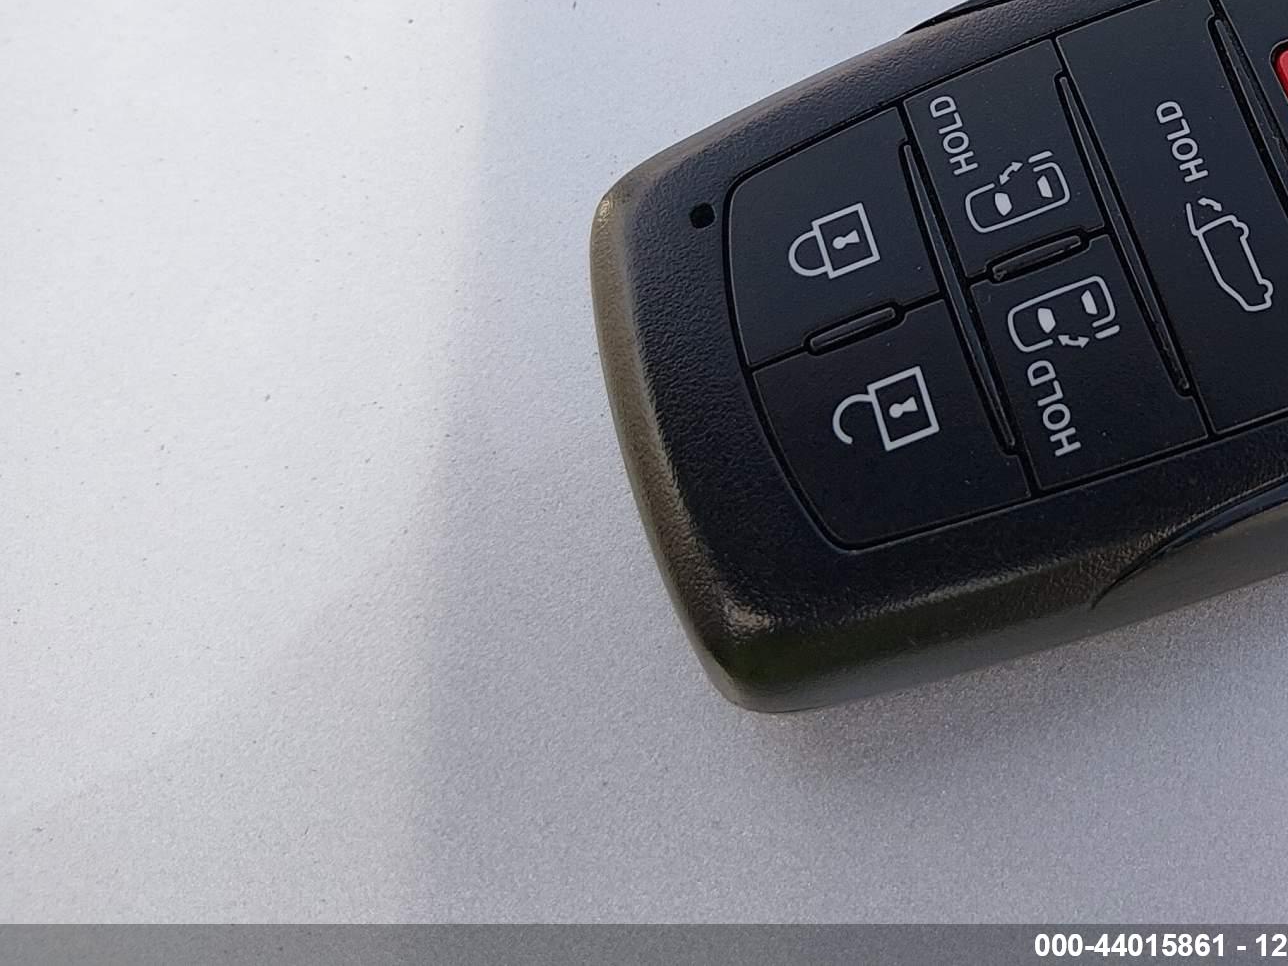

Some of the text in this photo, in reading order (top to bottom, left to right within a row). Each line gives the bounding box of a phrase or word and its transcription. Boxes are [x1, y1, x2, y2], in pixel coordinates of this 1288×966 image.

[930, 97, 977, 174] HOLD
[1157, 102, 1208, 181] HOLD
[1028, 361, 1080, 456] HOLD
